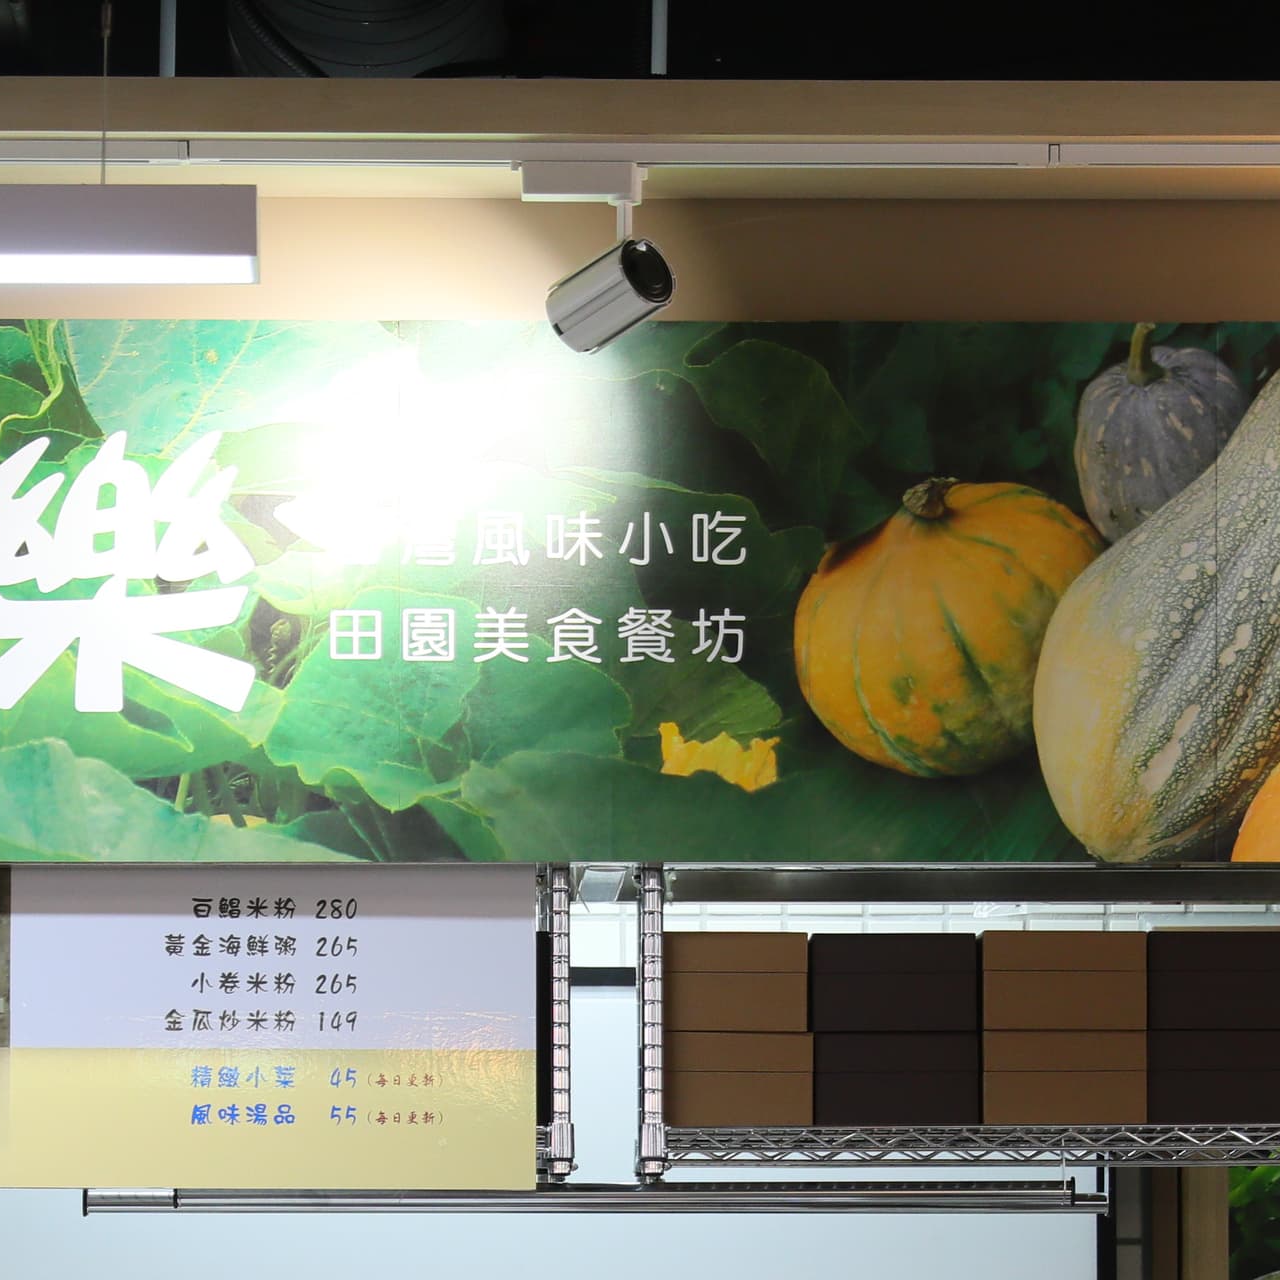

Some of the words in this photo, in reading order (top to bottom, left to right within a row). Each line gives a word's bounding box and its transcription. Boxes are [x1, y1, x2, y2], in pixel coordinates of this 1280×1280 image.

[403, 511, 748, 567] 風味小吃
[329, 606, 747, 663] 田園美食餐坊
[315, 899, 358, 919] 280
[164, 933, 297, 957] 黃金海鮮粥
[315, 936, 358, 957] 265
[191, 971, 297, 994] 小卷米粉
[315, 974, 358, 994] 265
[164, 1009, 297, 1032] 金瓜炒米粉
[319, 1011, 358, 1032] 149
[330, 1067, 357, 1088] 45
[191, 1103, 296, 1126] 風味湯品
[330, 1105, 357, 1126] 55
